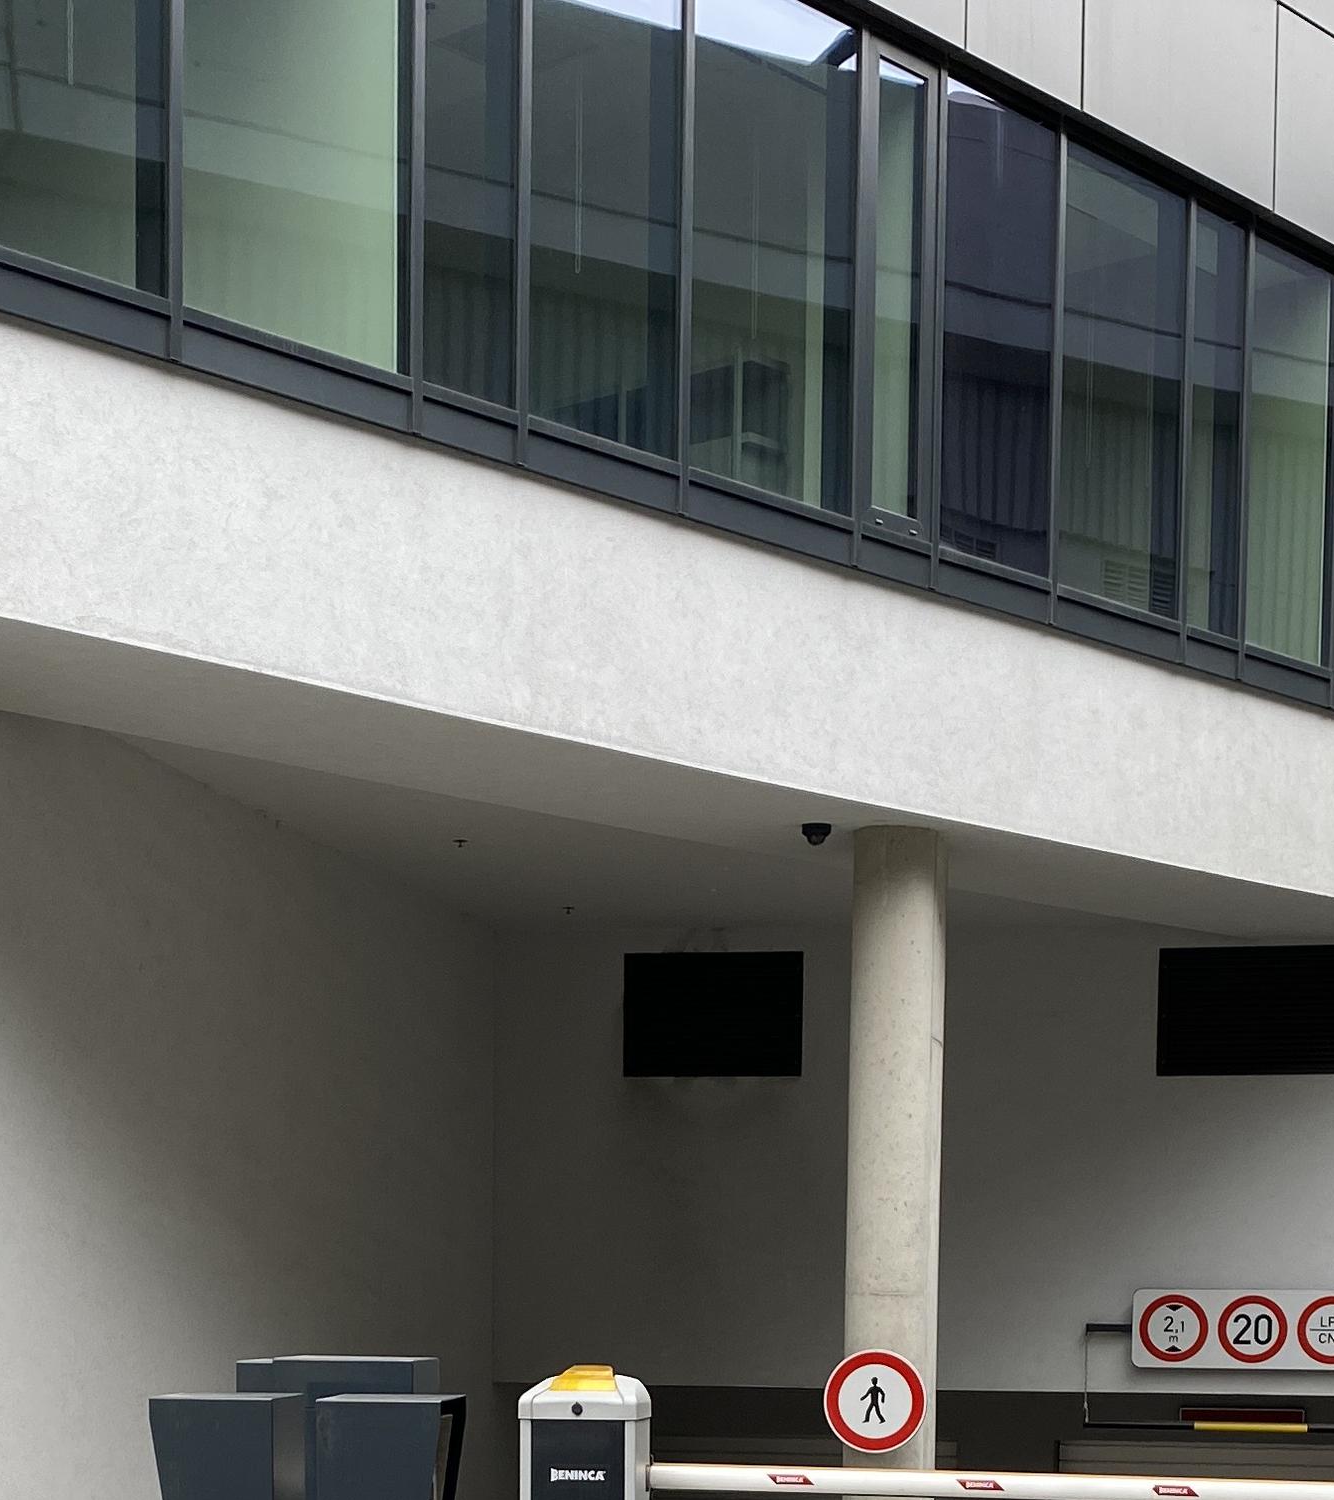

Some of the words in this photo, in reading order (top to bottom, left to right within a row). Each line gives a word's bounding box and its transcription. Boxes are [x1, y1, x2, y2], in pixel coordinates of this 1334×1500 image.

[1163, 1315, 1185, 1334] 2,1
[1232, 1314, 1273, 1345] 20
[1168, 1335, 1179, 1343] m
